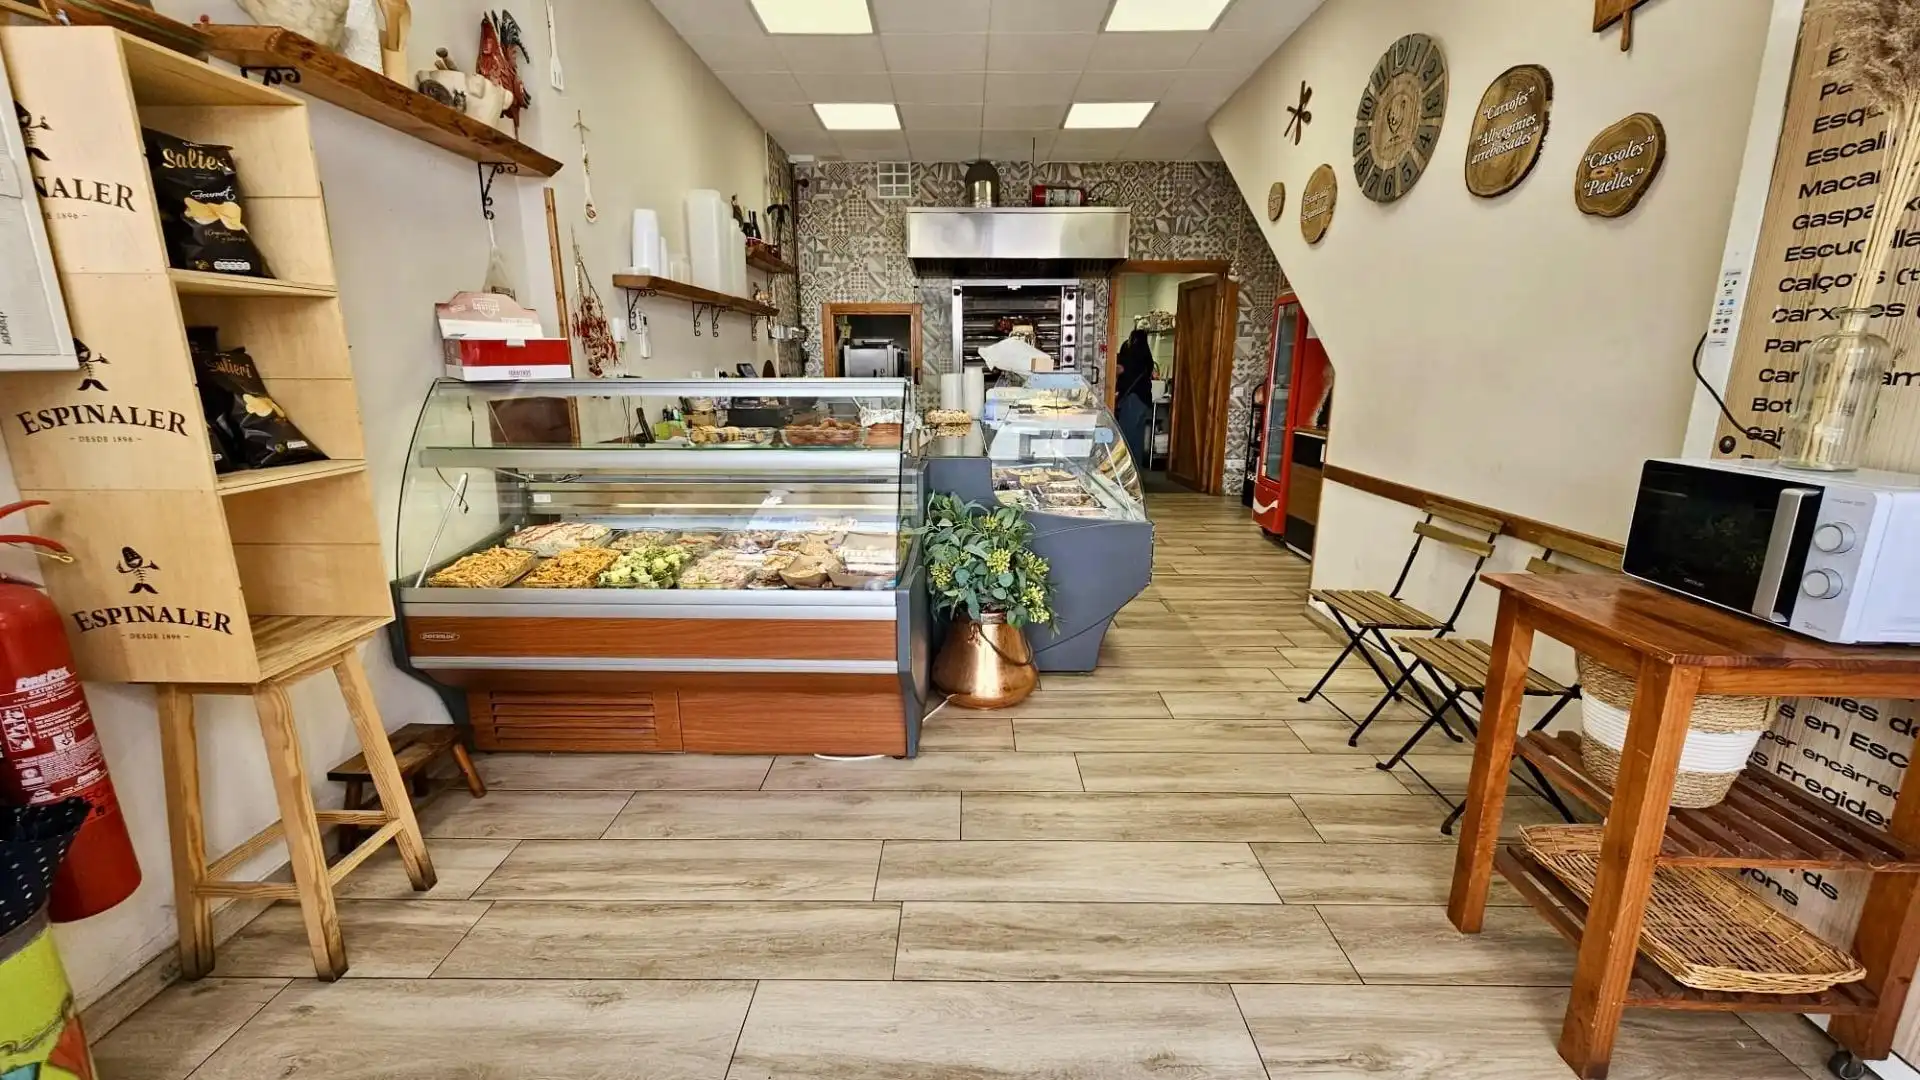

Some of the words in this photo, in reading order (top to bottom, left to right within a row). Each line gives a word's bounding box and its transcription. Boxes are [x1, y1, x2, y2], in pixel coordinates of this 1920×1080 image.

[33, 176, 137, 213] NALER
[16, 403, 189, 437] ESPINALER
[71, 605, 233, 635] ESPINALER
[1804, 715, 1841, 740] en
